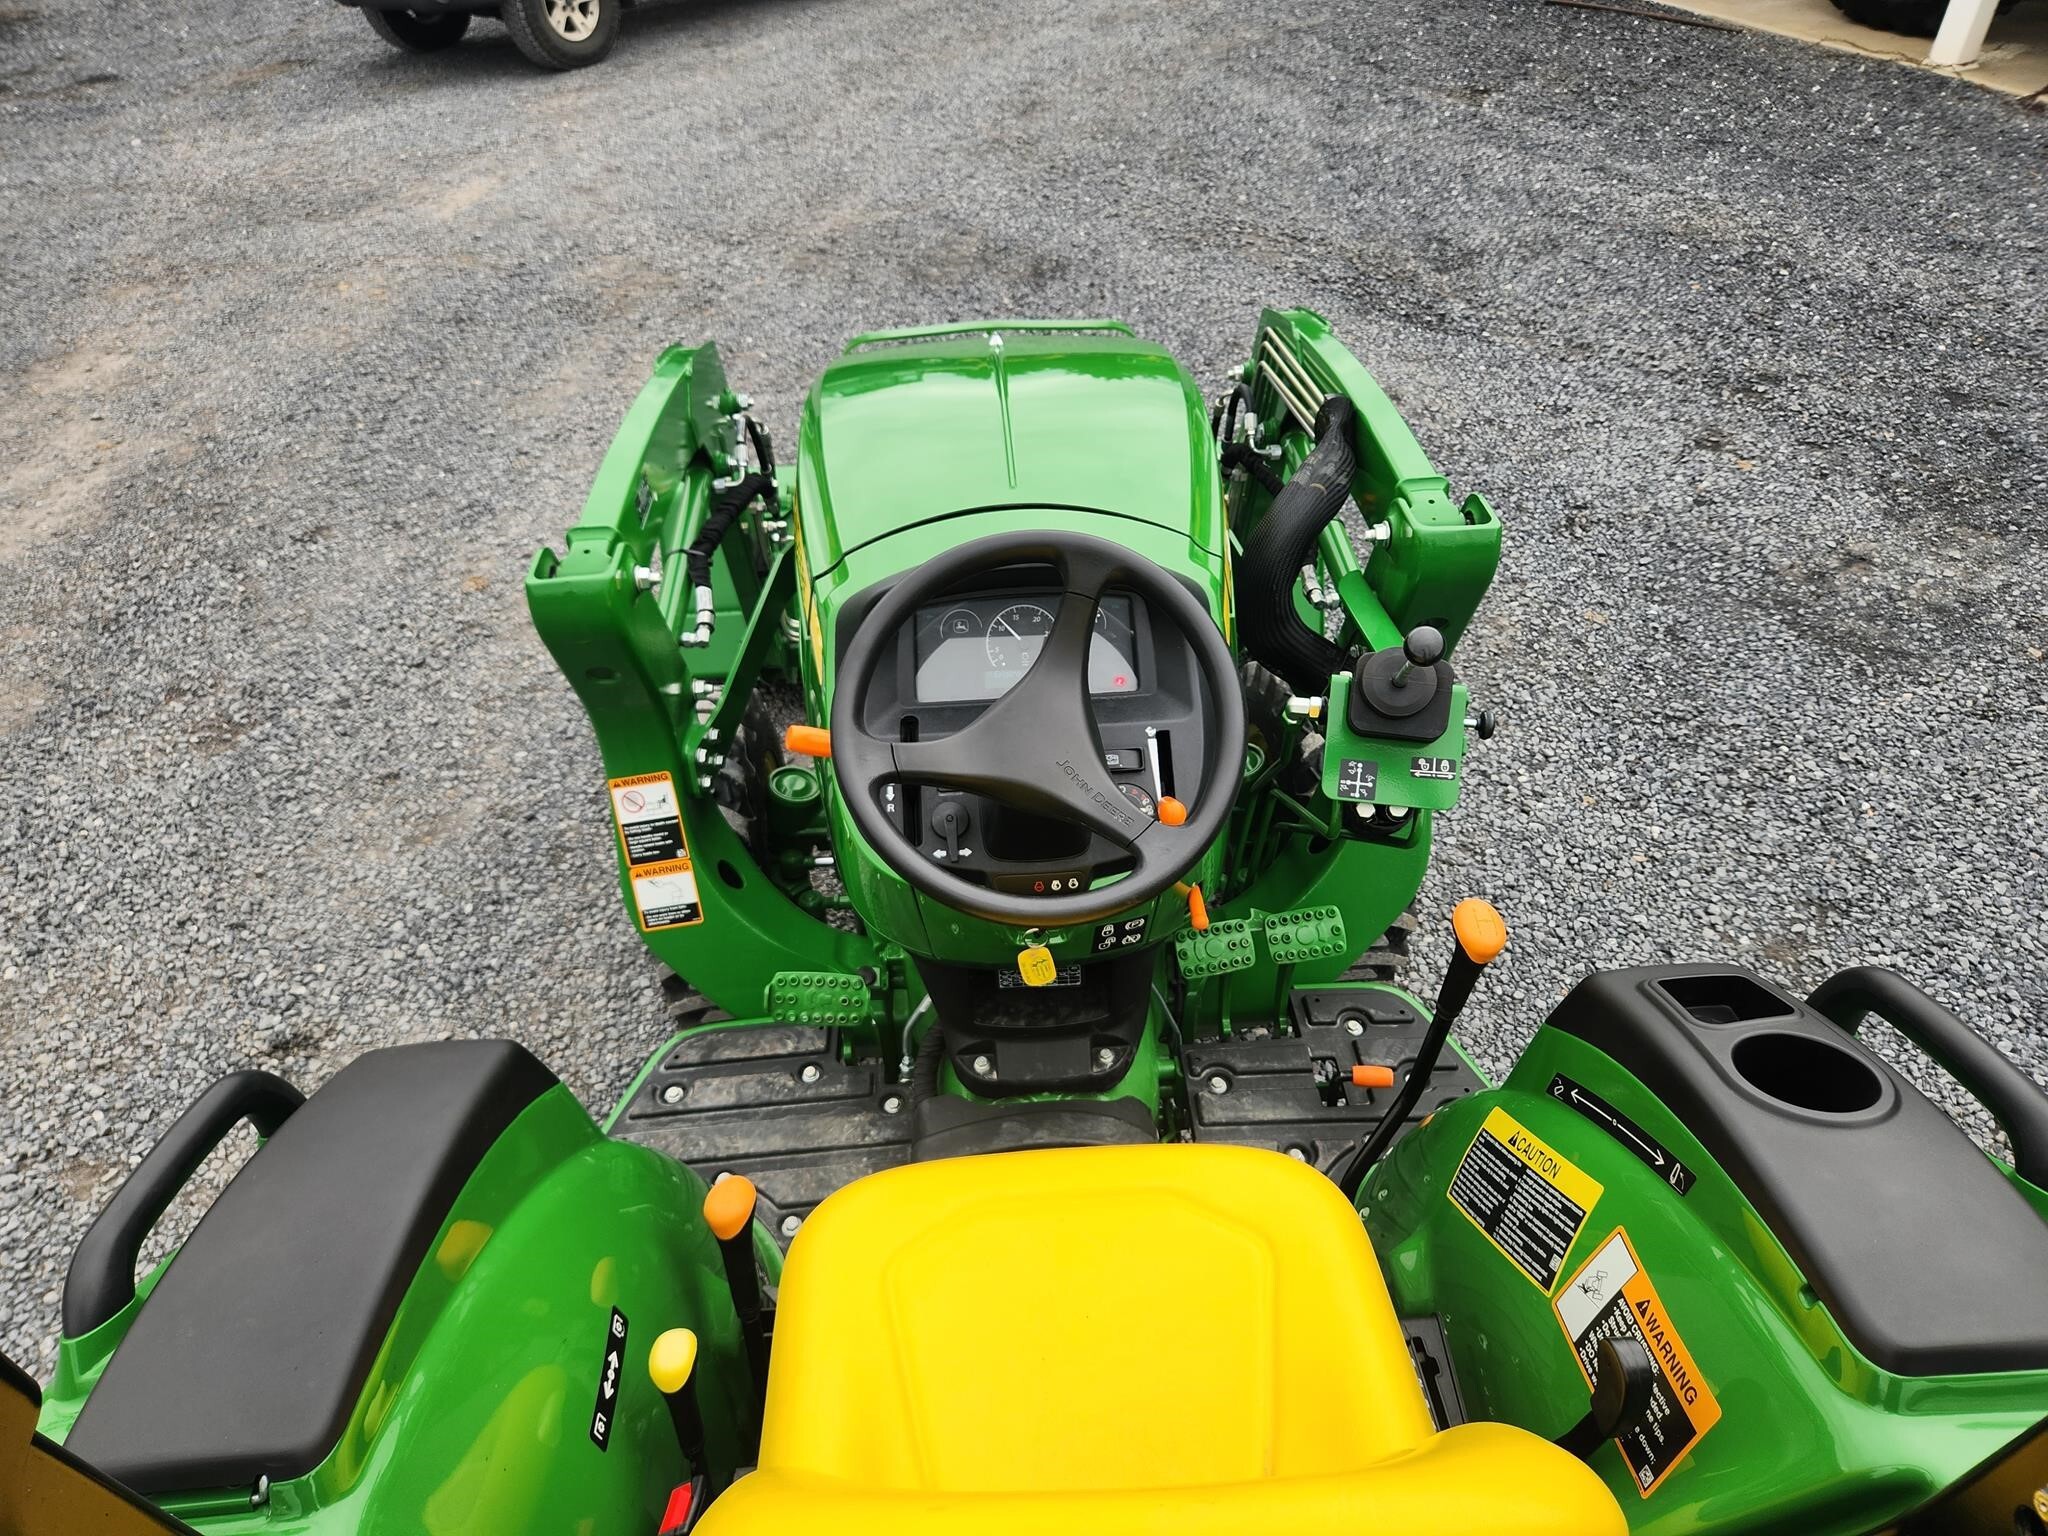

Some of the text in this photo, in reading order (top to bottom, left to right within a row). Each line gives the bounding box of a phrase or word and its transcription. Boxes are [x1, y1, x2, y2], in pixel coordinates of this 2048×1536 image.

[621, 772, 668, 787] WARNING
[1056, 760, 1135, 827] JOHN DEERE
[887, 803, 895, 812] R
[643, 862, 689, 876] WARNING
[1516, 1137, 1562, 1179] CAUTION
[1617, 1298, 1635, 1325] AVOID
[1646, 1312, 1698, 1406] WARNING
